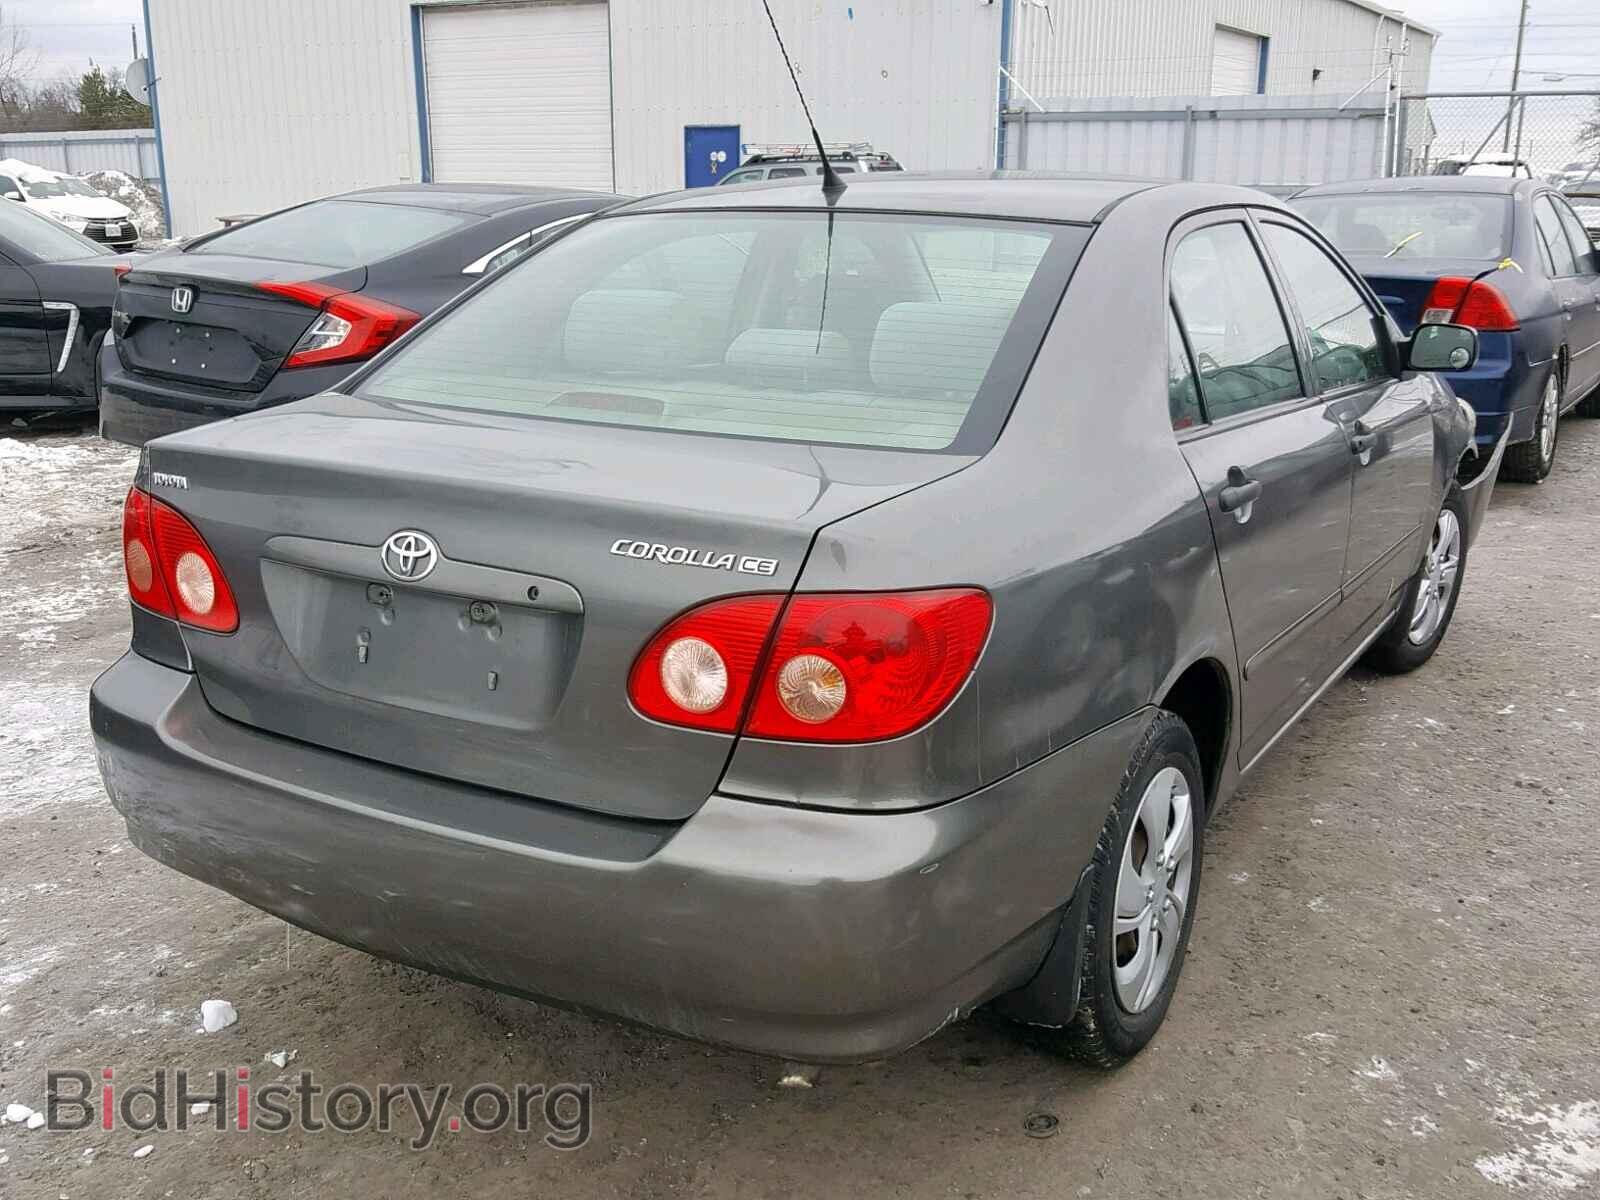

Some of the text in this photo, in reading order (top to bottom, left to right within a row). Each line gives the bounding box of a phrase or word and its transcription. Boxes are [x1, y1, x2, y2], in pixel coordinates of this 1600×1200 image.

[153, 472, 188, 490] TOYOTA
[610, 539, 778, 577] COROLLA CE
